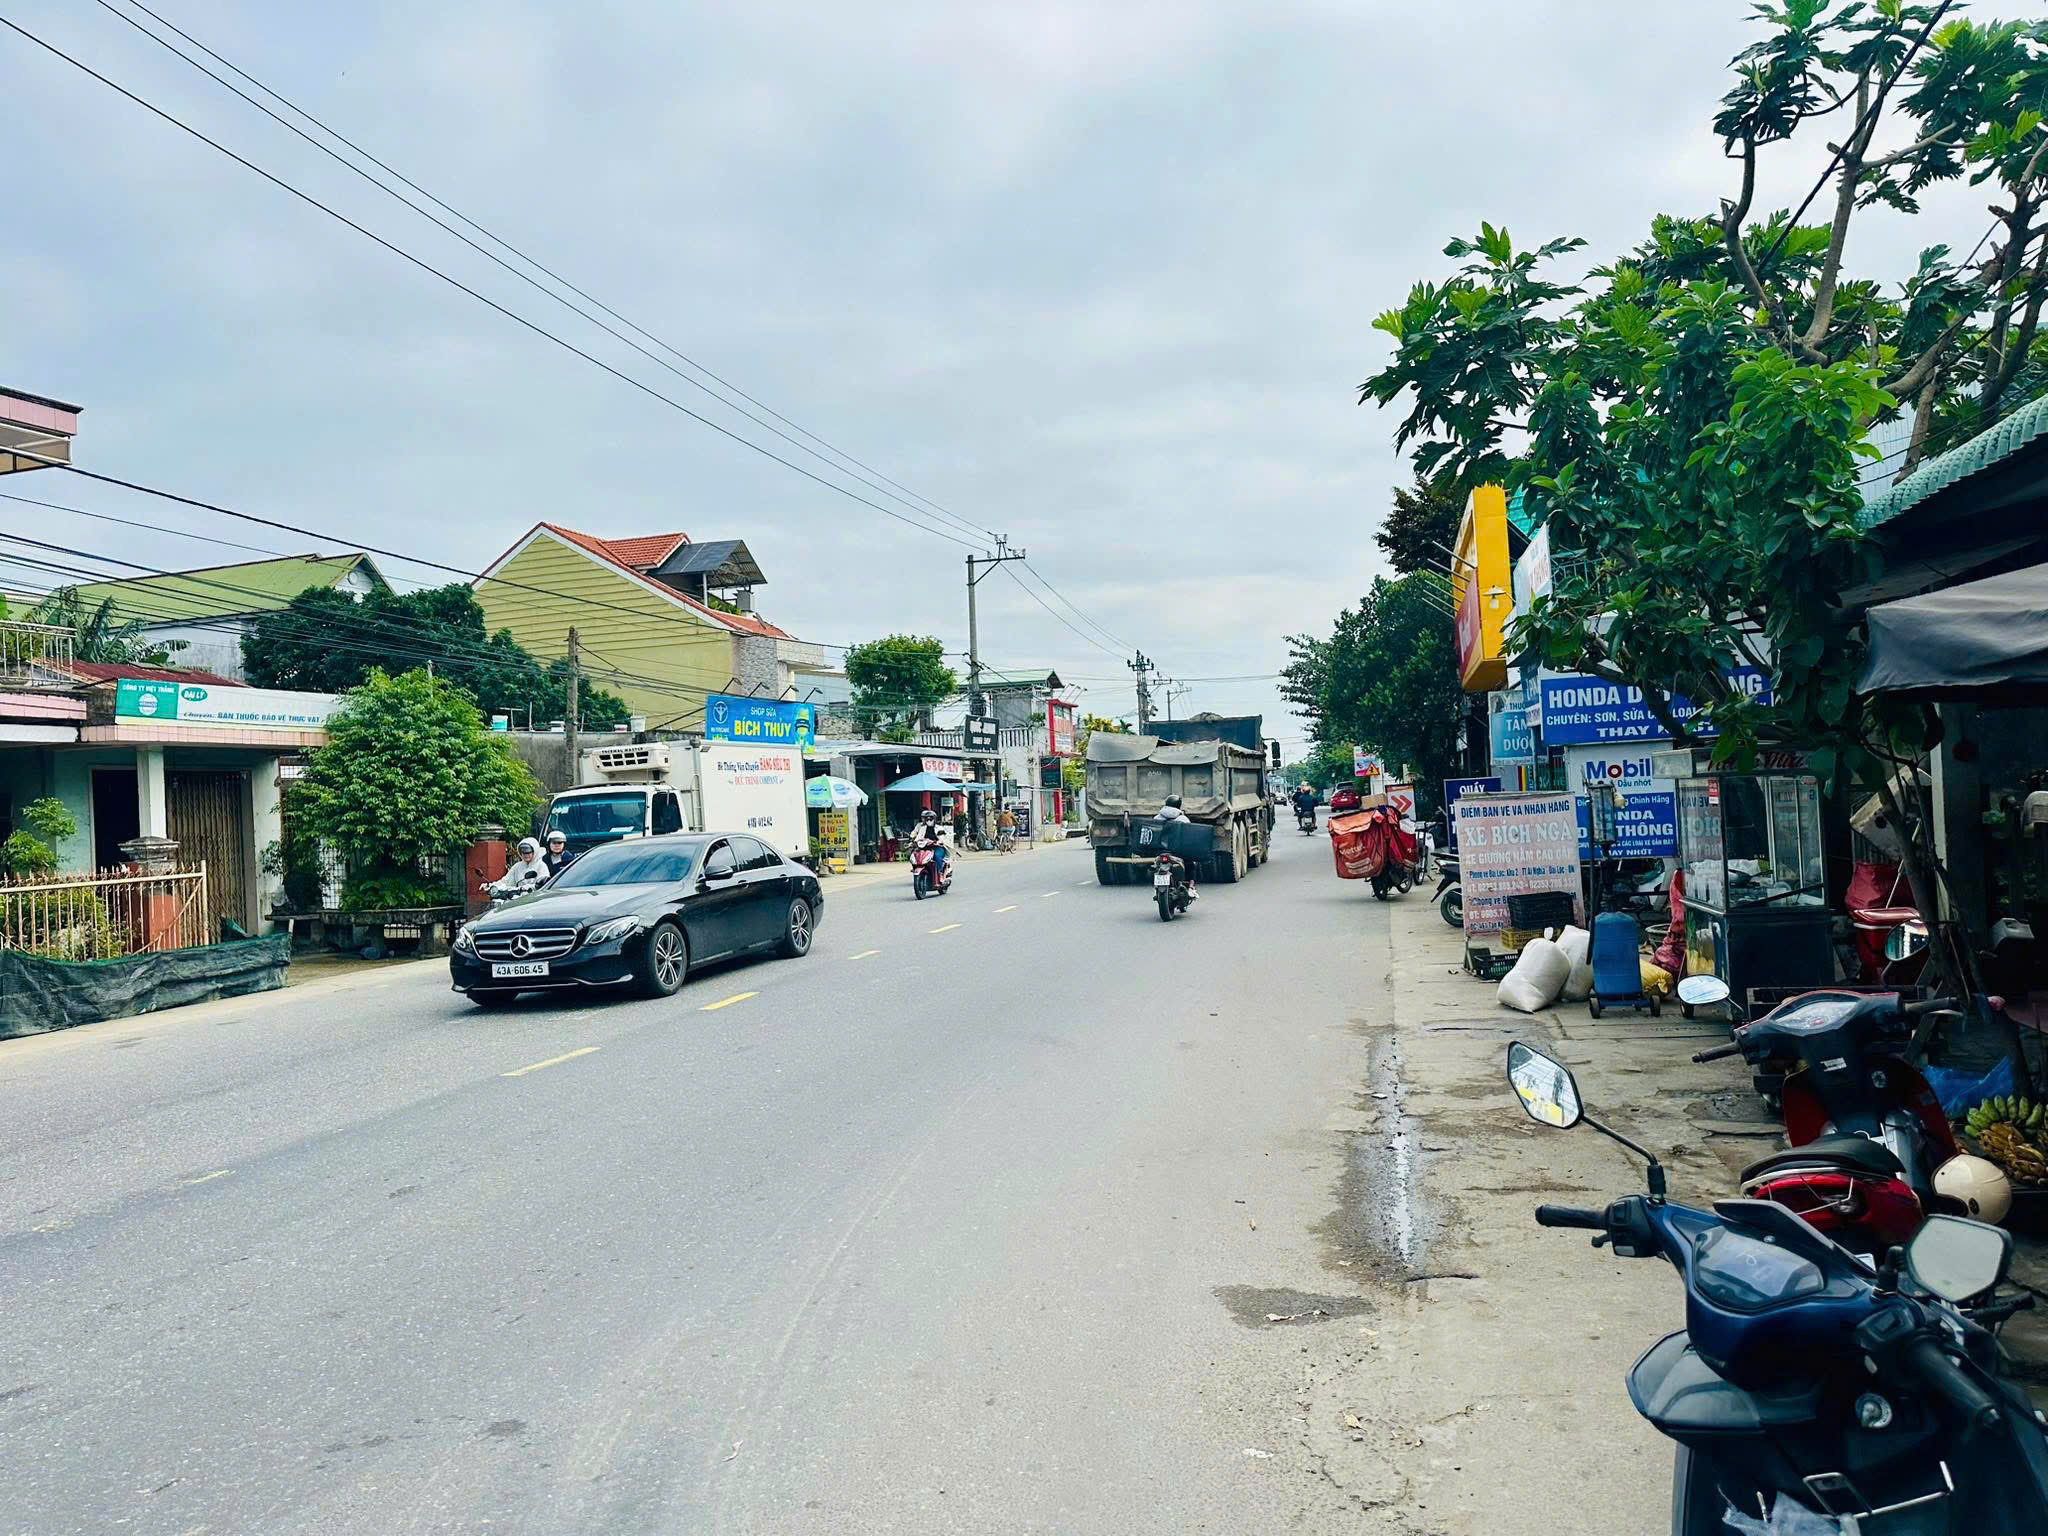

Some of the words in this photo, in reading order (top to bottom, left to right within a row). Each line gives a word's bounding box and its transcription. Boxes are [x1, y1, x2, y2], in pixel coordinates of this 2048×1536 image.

[1549, 688, 1621, 709] HONDA
[750, 706, 765, 716] SHOP
[734, 716, 760, 736] BÍCH
[1596, 725, 1650, 738] THAY
[1586, 758, 1651, 779] Mobil
[1465, 827, 1488, 847] XE
[1615, 821, 1674, 837] THÔNG
